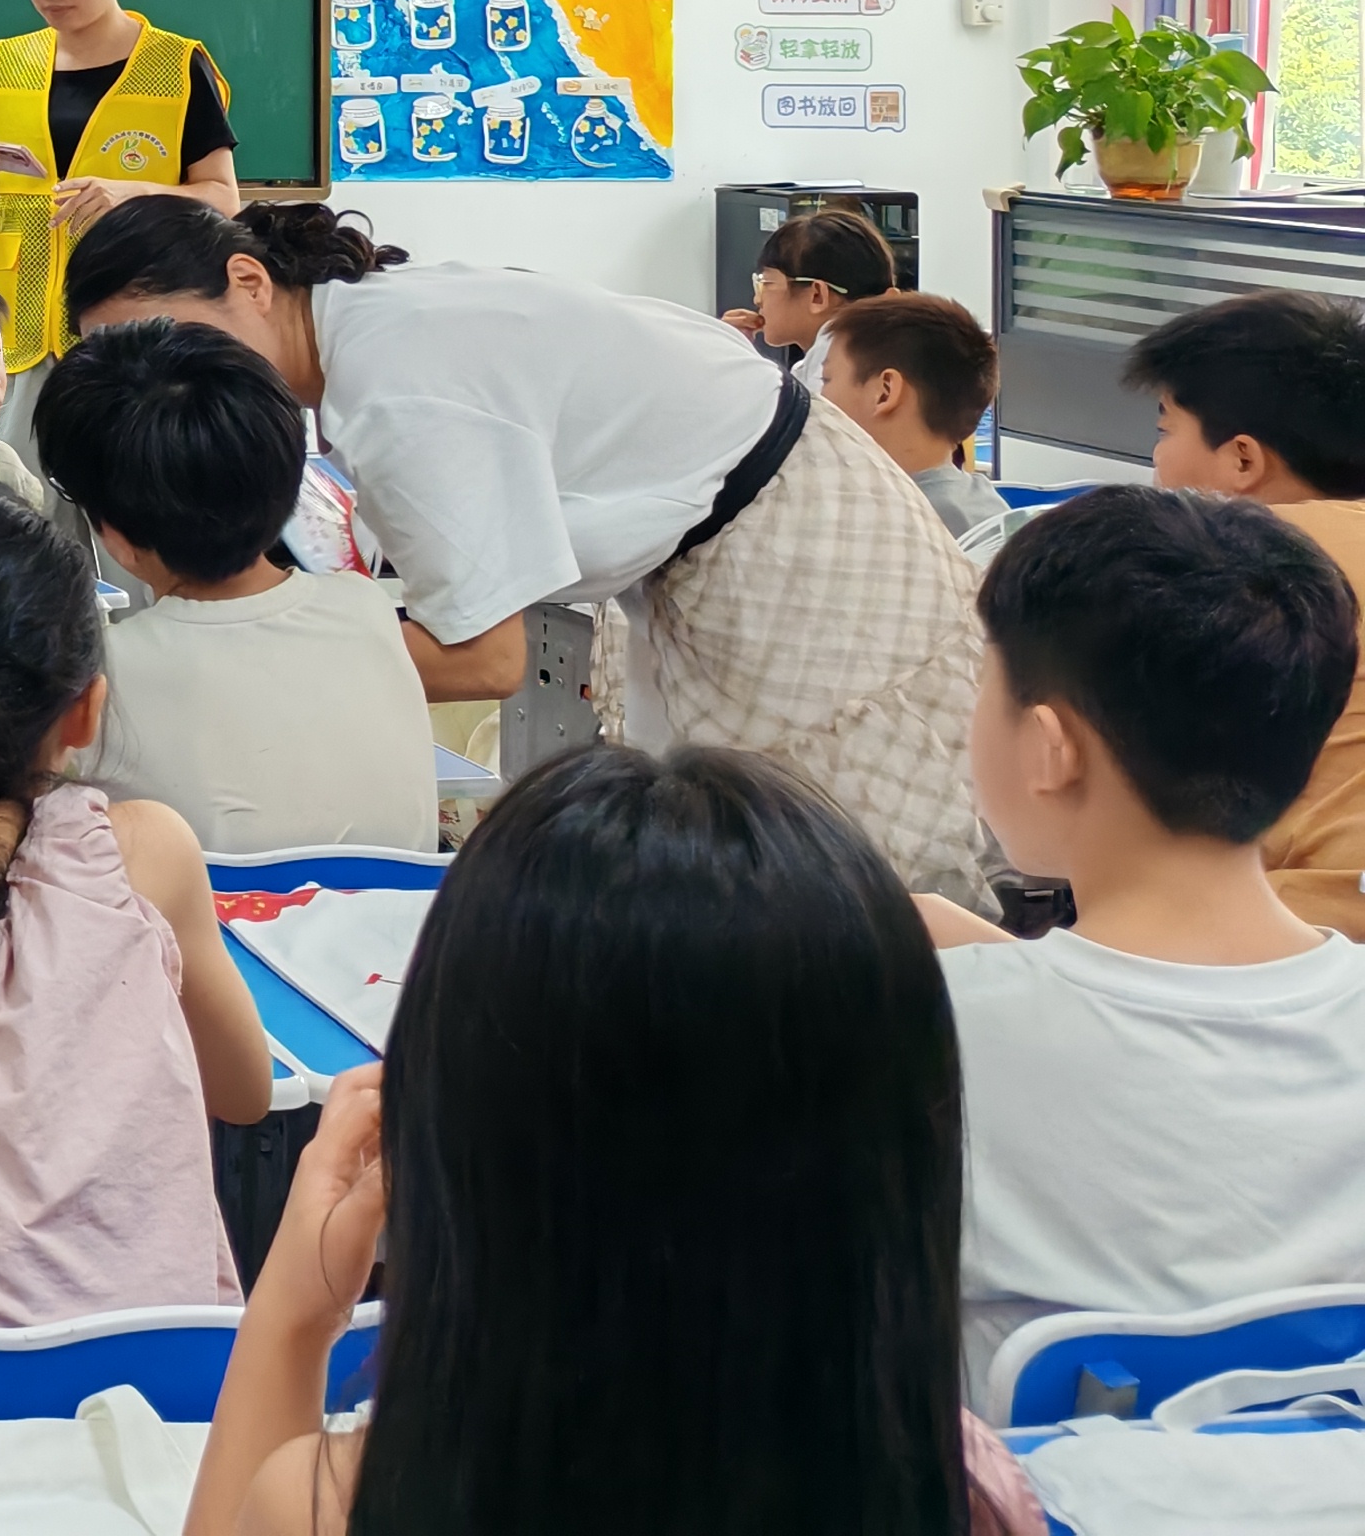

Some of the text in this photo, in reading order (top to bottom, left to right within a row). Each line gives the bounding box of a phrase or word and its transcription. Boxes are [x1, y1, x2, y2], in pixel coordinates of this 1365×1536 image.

[779, 38, 861, 60] 轻拿轻放
[776, 95, 857, 118] 图书放回
